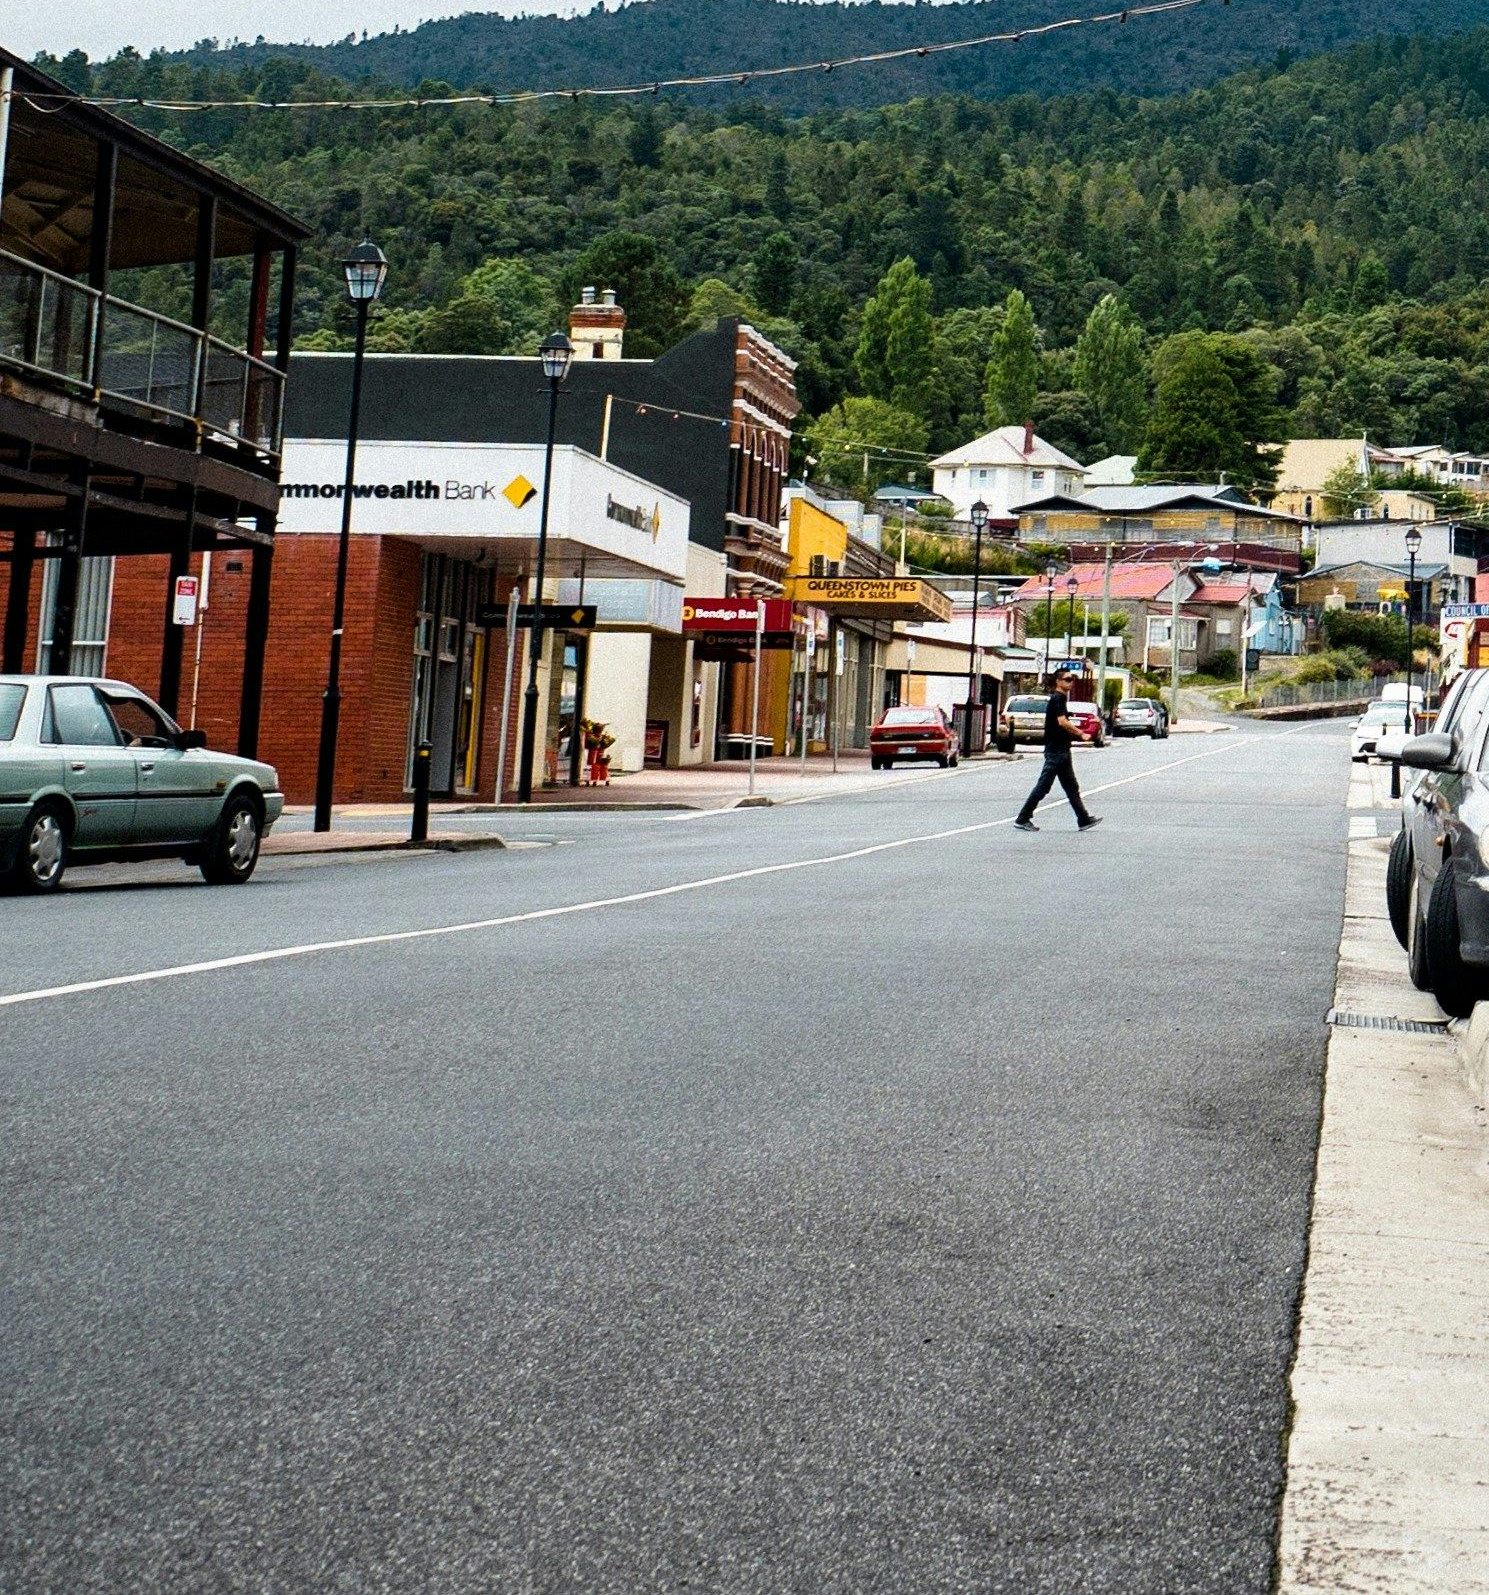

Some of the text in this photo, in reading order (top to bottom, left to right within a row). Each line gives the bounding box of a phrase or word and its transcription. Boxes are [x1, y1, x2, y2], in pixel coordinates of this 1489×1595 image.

[445, 480, 496, 501] Bank
[808, 580, 917, 592] QUEENSTOWN PIES
[827, 591, 856, 599] CAKES
[695, 608, 758, 620] Bendigo Ban
